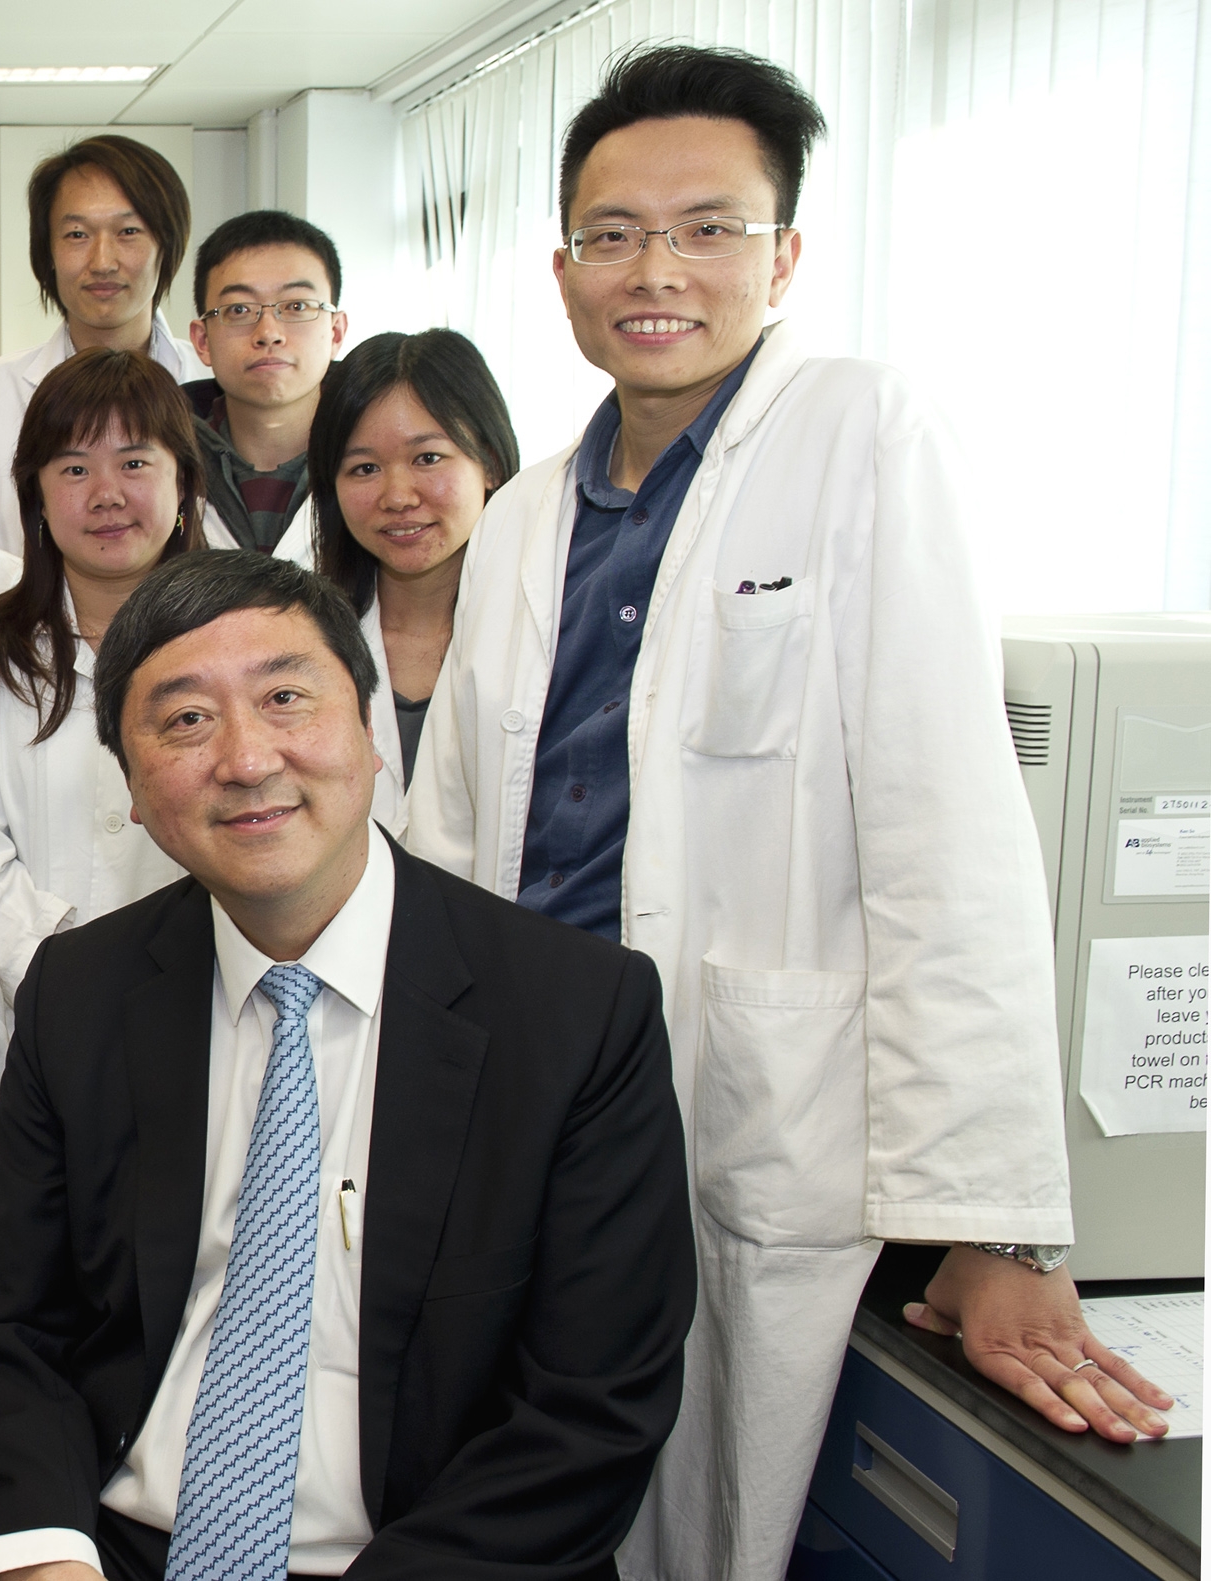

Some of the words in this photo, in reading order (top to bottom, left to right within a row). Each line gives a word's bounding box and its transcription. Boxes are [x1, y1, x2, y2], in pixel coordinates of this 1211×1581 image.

[1119, 806, 1137, 814] Serial
[1125, 838, 1140, 848] AB
[1128, 964, 1183, 979] Please
[1146, 986, 1184, 1001] after
[1157, 1009, 1200, 1023] leave
[1145, 1030, 1208, 1048] product
[1131, 1052, 1175, 1067] towel
[1180, 1054, 1200, 1066] on
[1125, 1074, 1163, 1089] PCR
